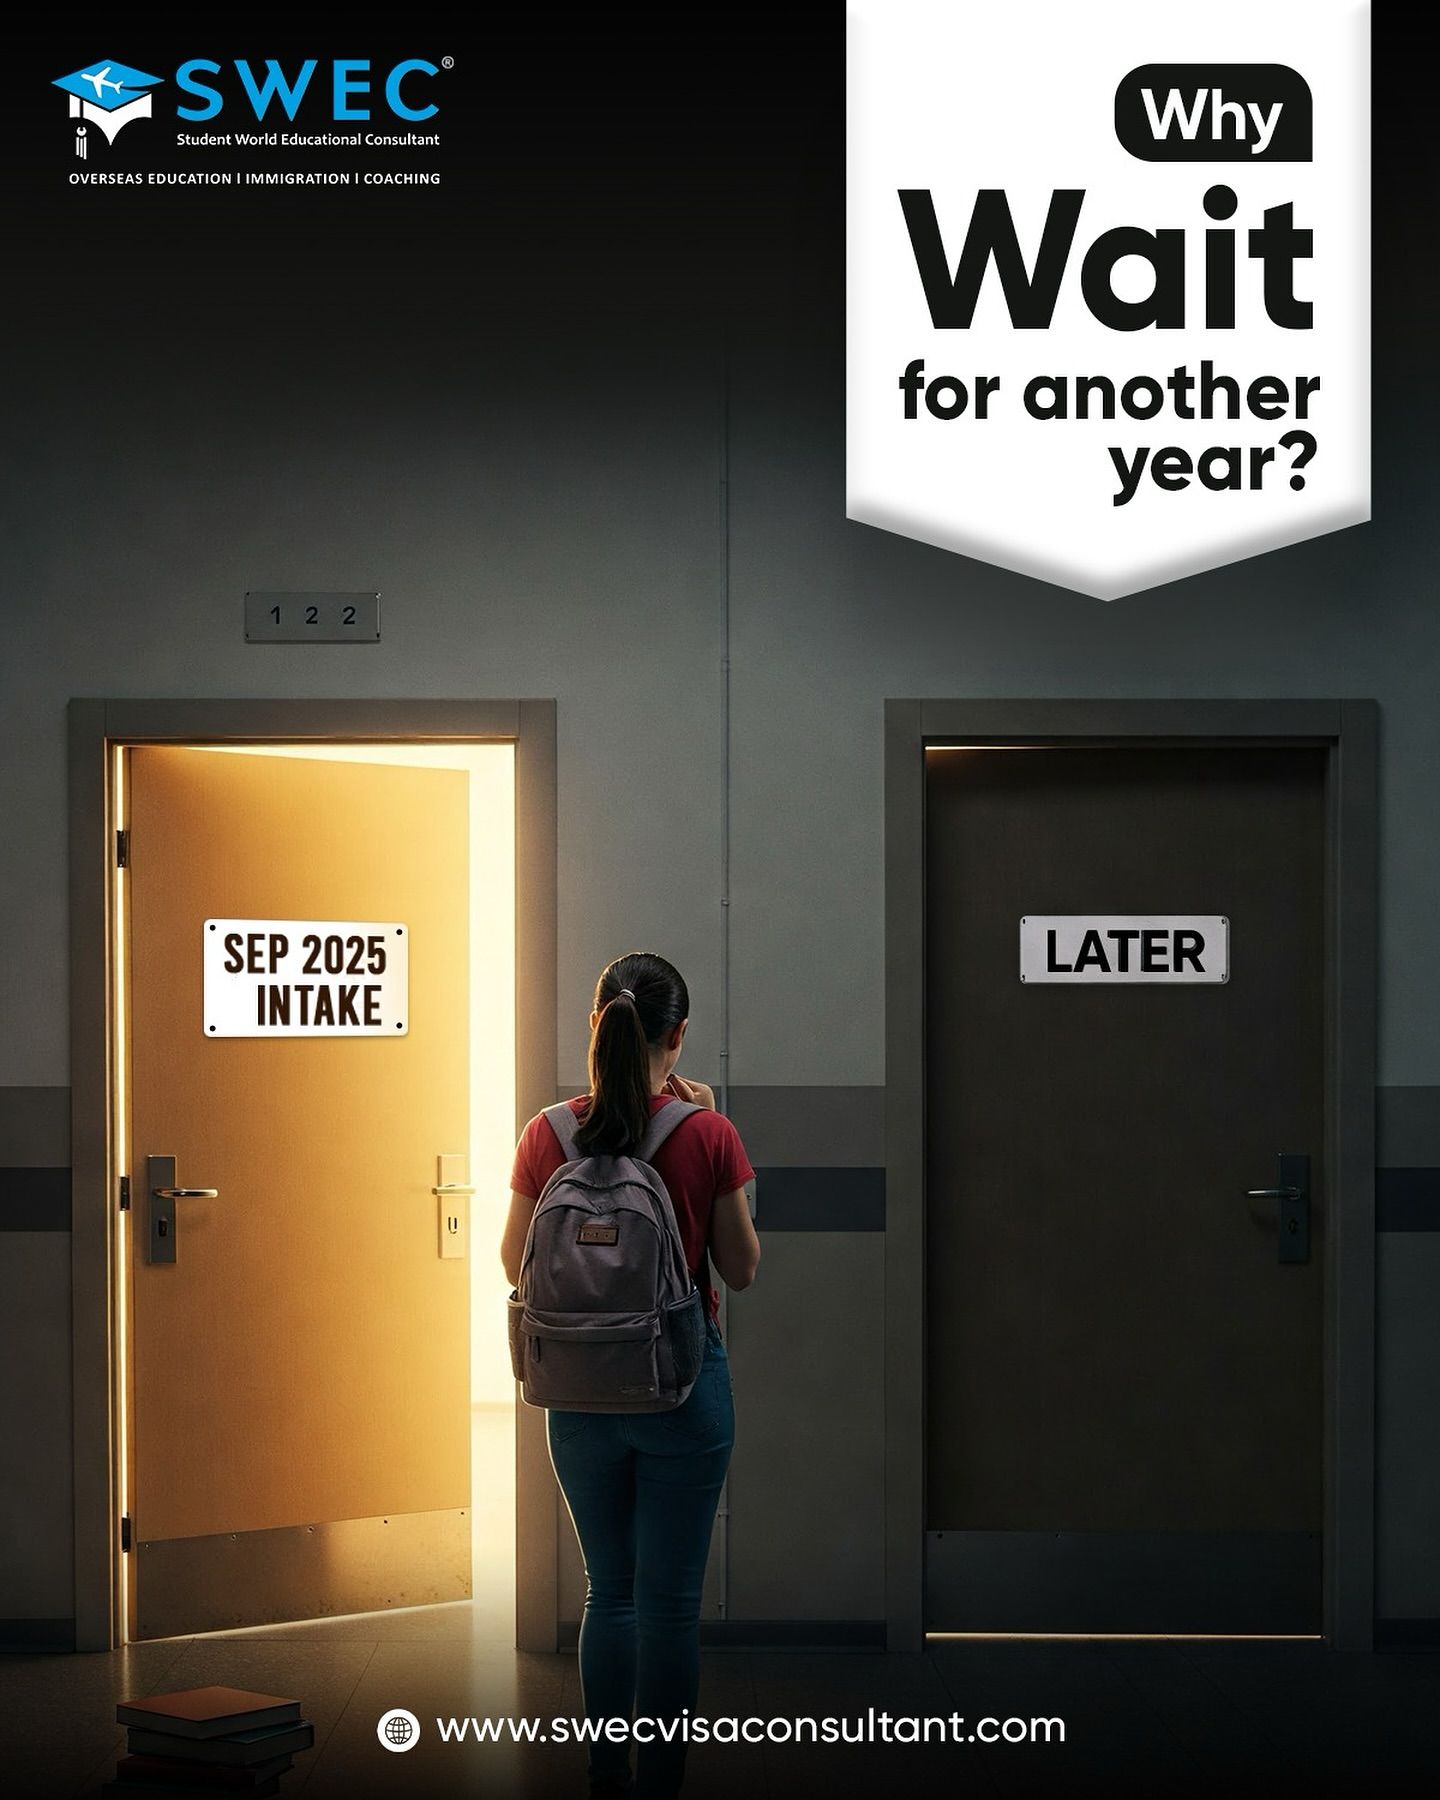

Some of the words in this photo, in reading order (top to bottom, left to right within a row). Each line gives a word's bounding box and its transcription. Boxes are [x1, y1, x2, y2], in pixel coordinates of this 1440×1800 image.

[224, 934, 288, 973] SEP
[303, 935, 387, 974] 2025
[1047, 930, 1206, 972] LATER
[257, 984, 382, 1025] INTAKE
